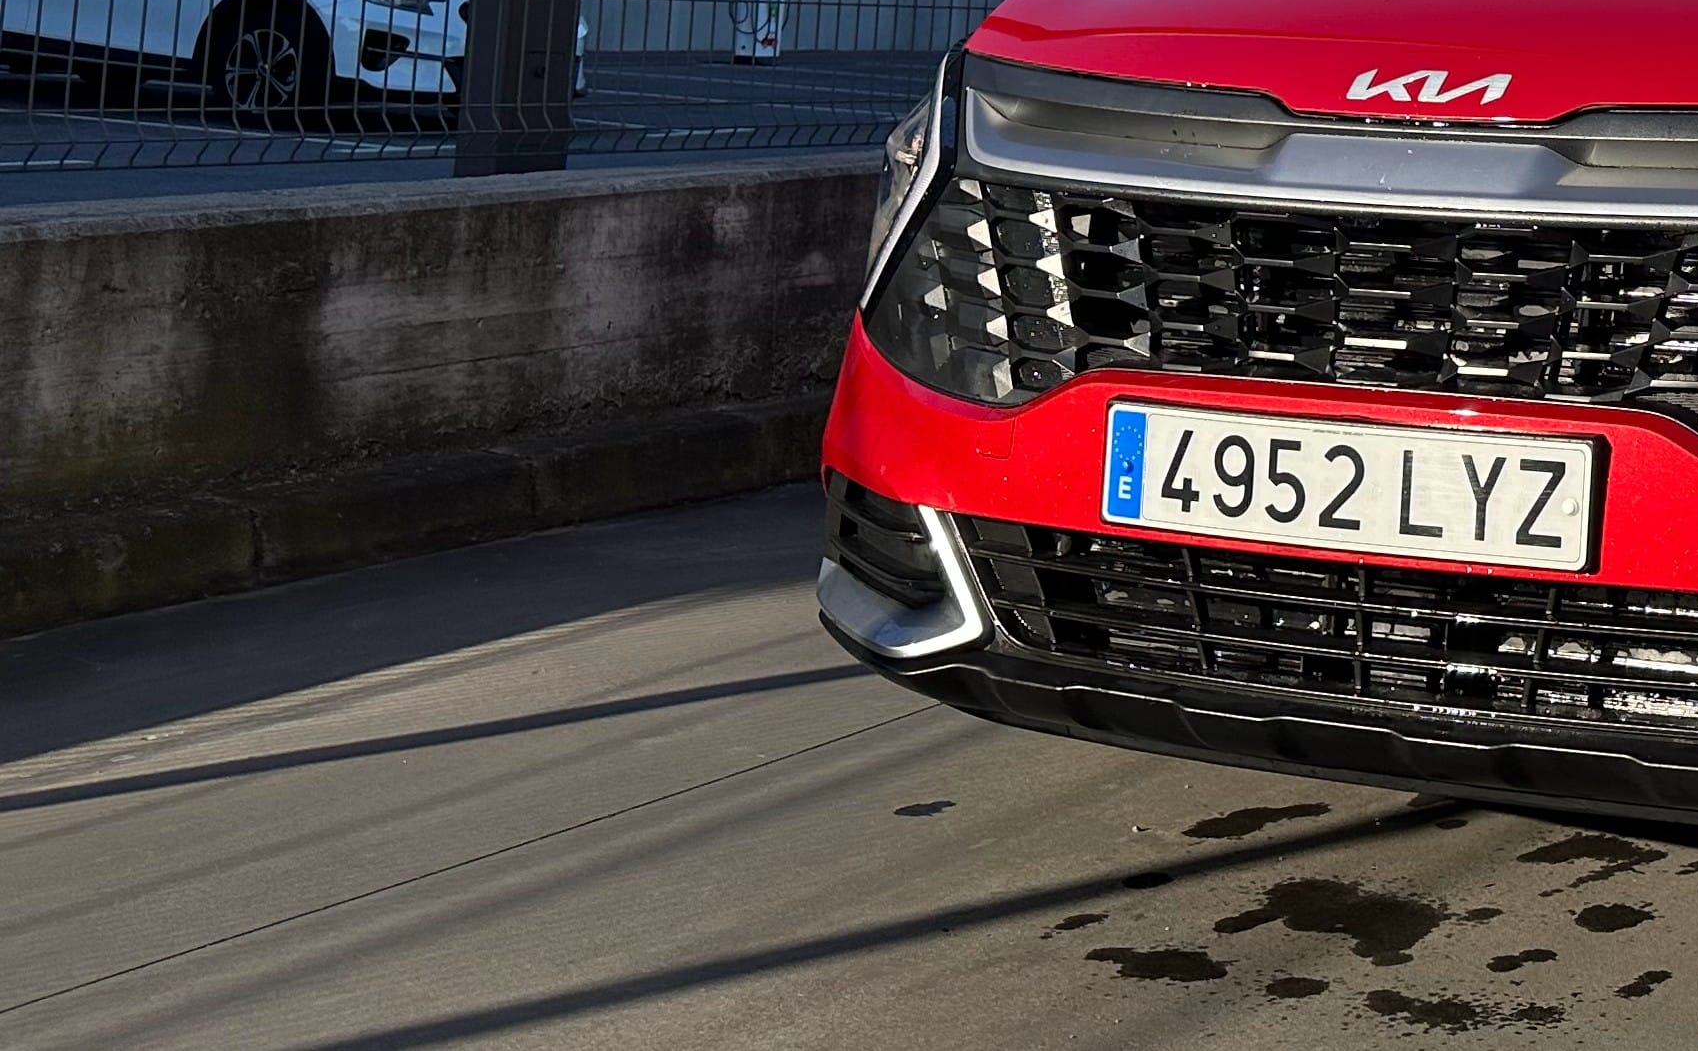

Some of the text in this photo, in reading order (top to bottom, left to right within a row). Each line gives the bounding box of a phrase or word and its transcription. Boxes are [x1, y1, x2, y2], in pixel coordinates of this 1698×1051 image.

[1346, 68, 1512, 105] KIA
[1118, 475, 1132, 500] E
[1160, 429, 1567, 548] 4952 LYZ
